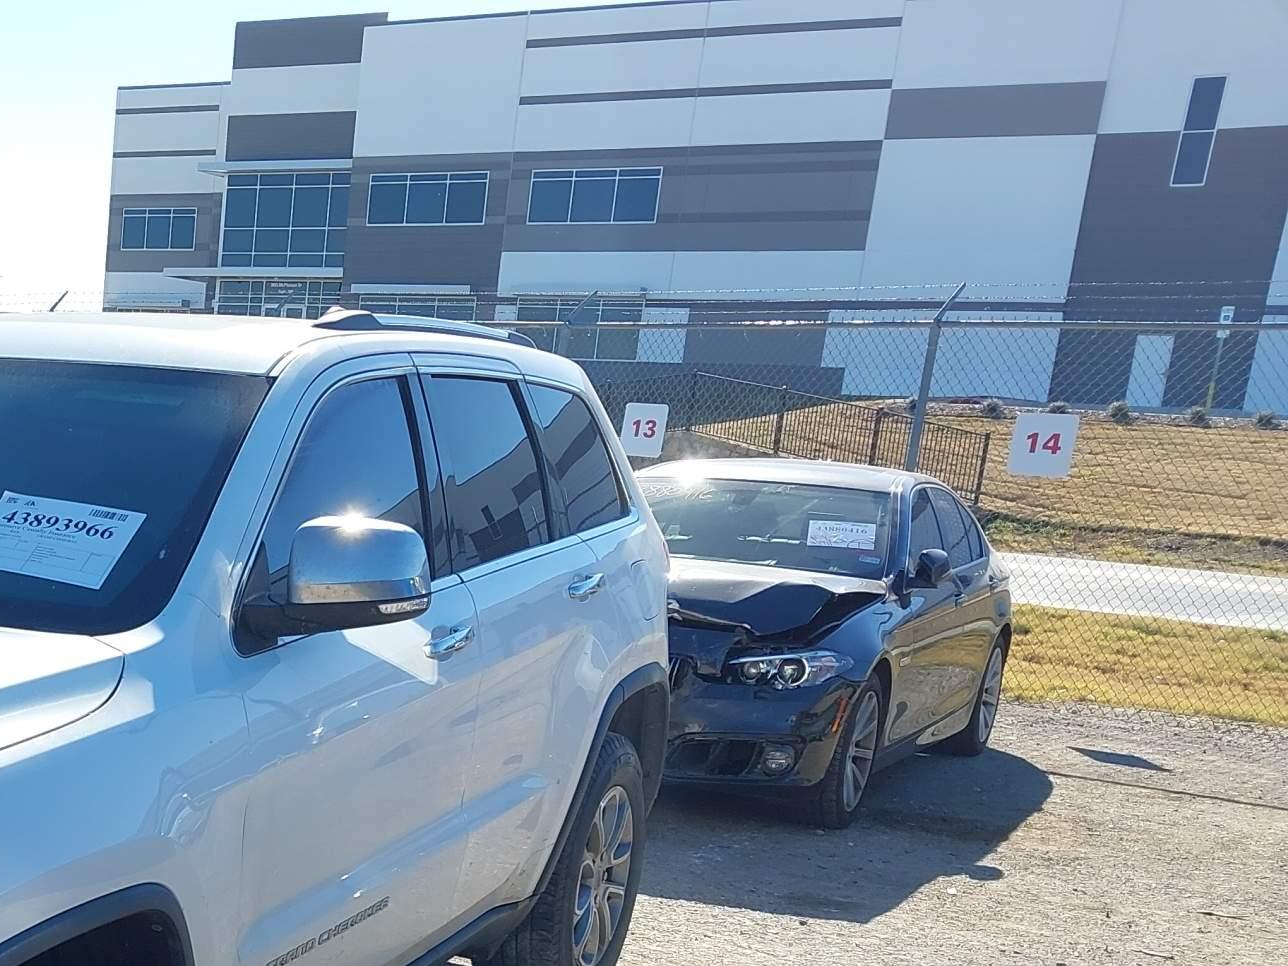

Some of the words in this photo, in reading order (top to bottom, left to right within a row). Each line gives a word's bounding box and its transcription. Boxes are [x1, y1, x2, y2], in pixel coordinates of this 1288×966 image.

[631, 418, 657, 439] 13
[1026, 432, 1062, 455] 14
[2, 509, 119, 541] 43893966
[317, 895, 391, 945] CHEROKEE
